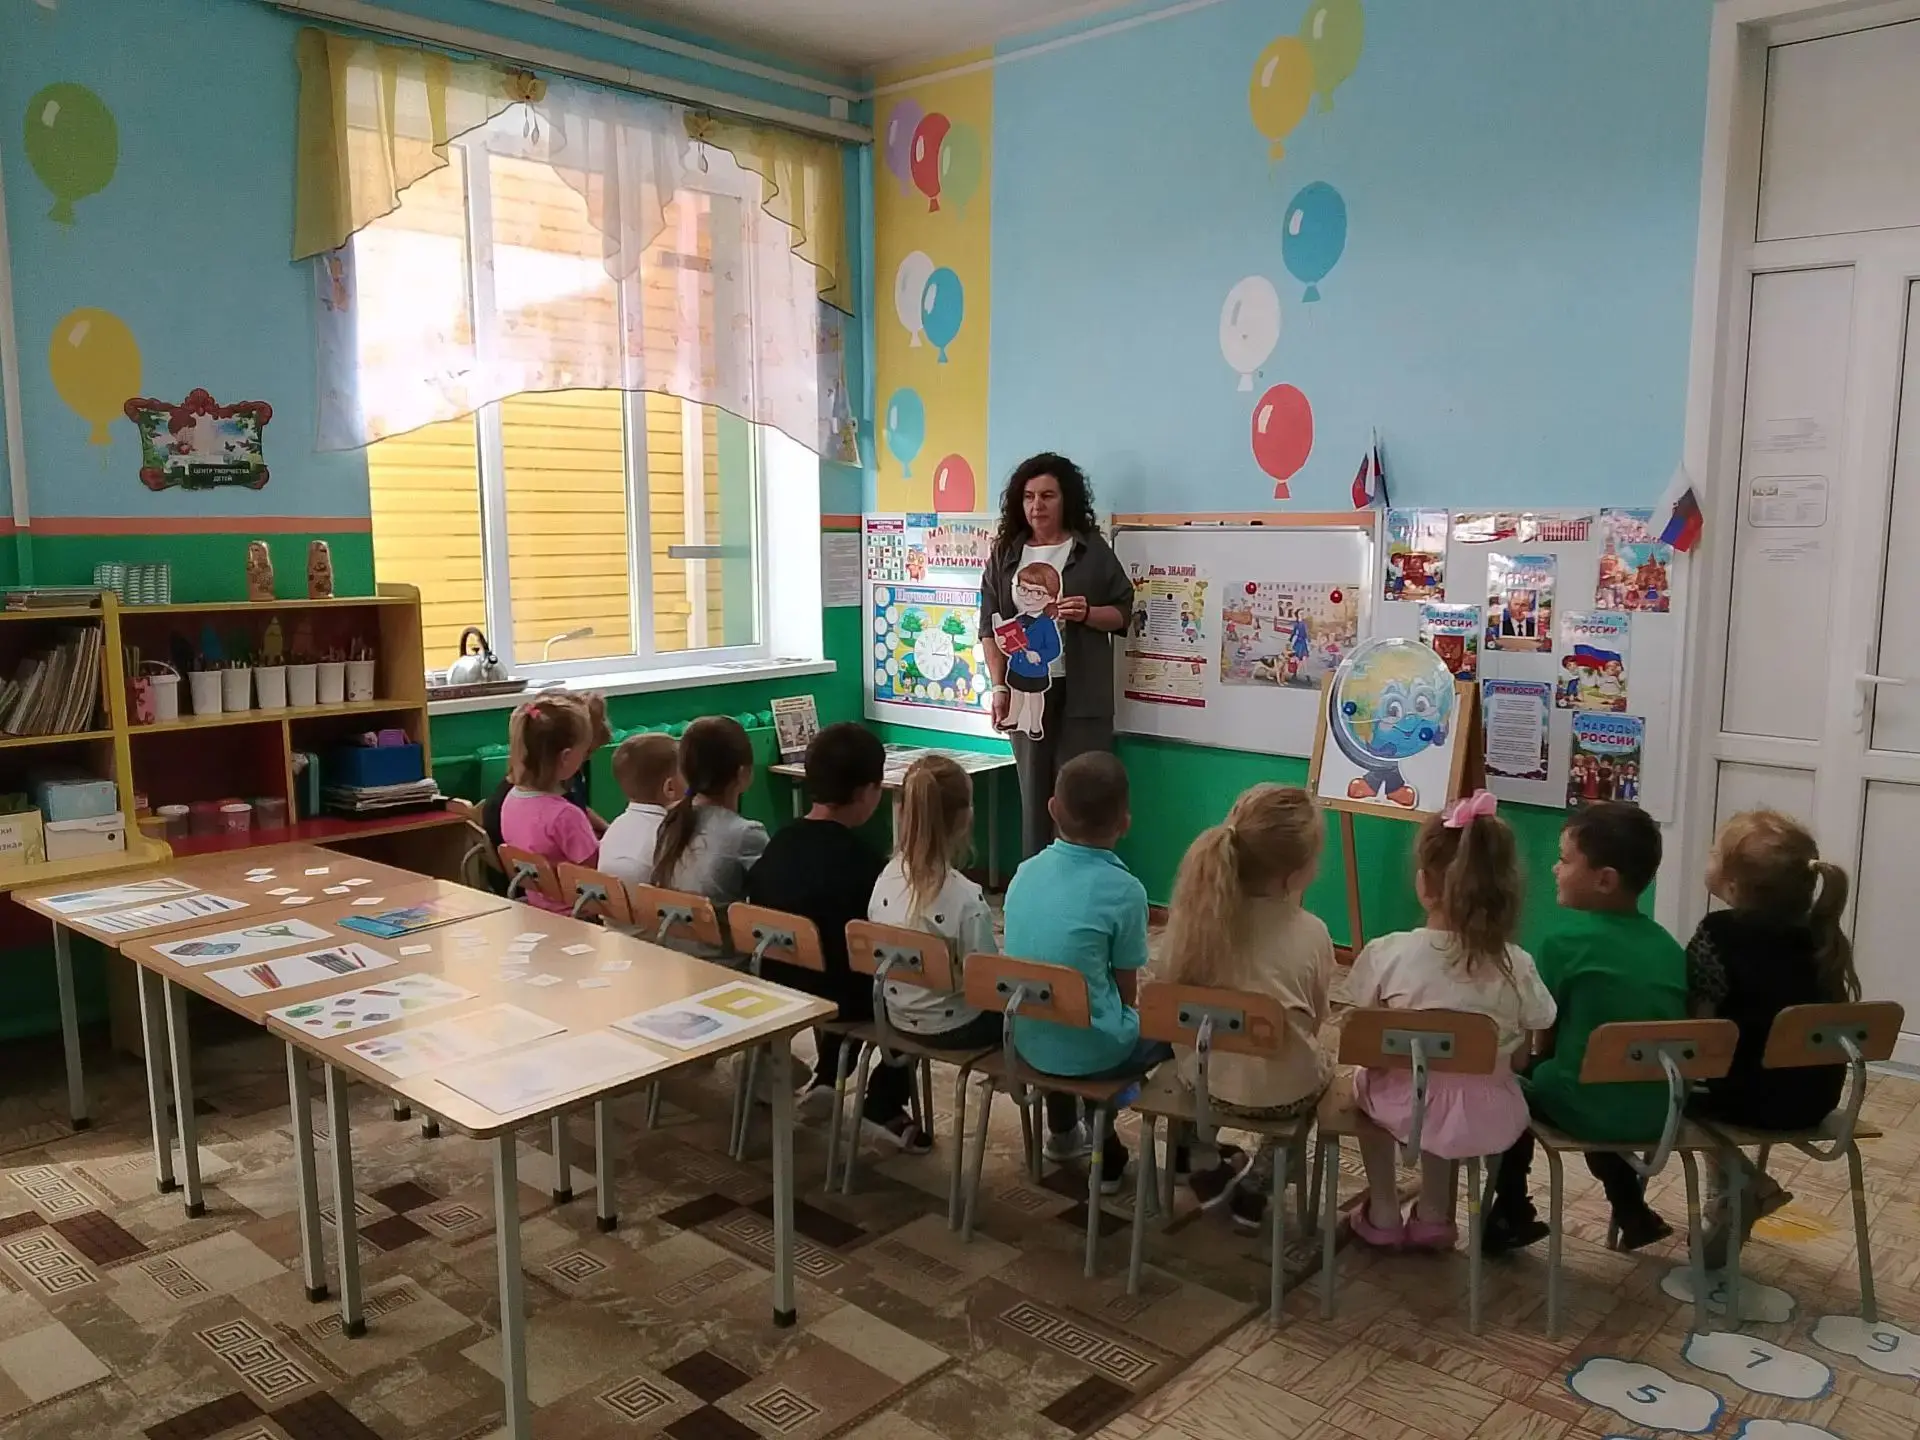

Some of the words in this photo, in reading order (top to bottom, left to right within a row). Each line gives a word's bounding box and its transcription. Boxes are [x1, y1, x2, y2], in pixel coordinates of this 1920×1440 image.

[1168, 563, 1197, 577] ЗНАНИЙ
[1428, 618, 1473, 627] РОССИИ
[1574, 624, 1618, 634] РОССИИ
[1583, 722, 1636, 734] НАРОДЫ
[1580, 732, 1635, 746] РОССИИ
[1867, 1331, 1901, 1353] 9
[1746, 1348, 1773, 1369] 7
[1626, 1384, 1666, 1404] 5
